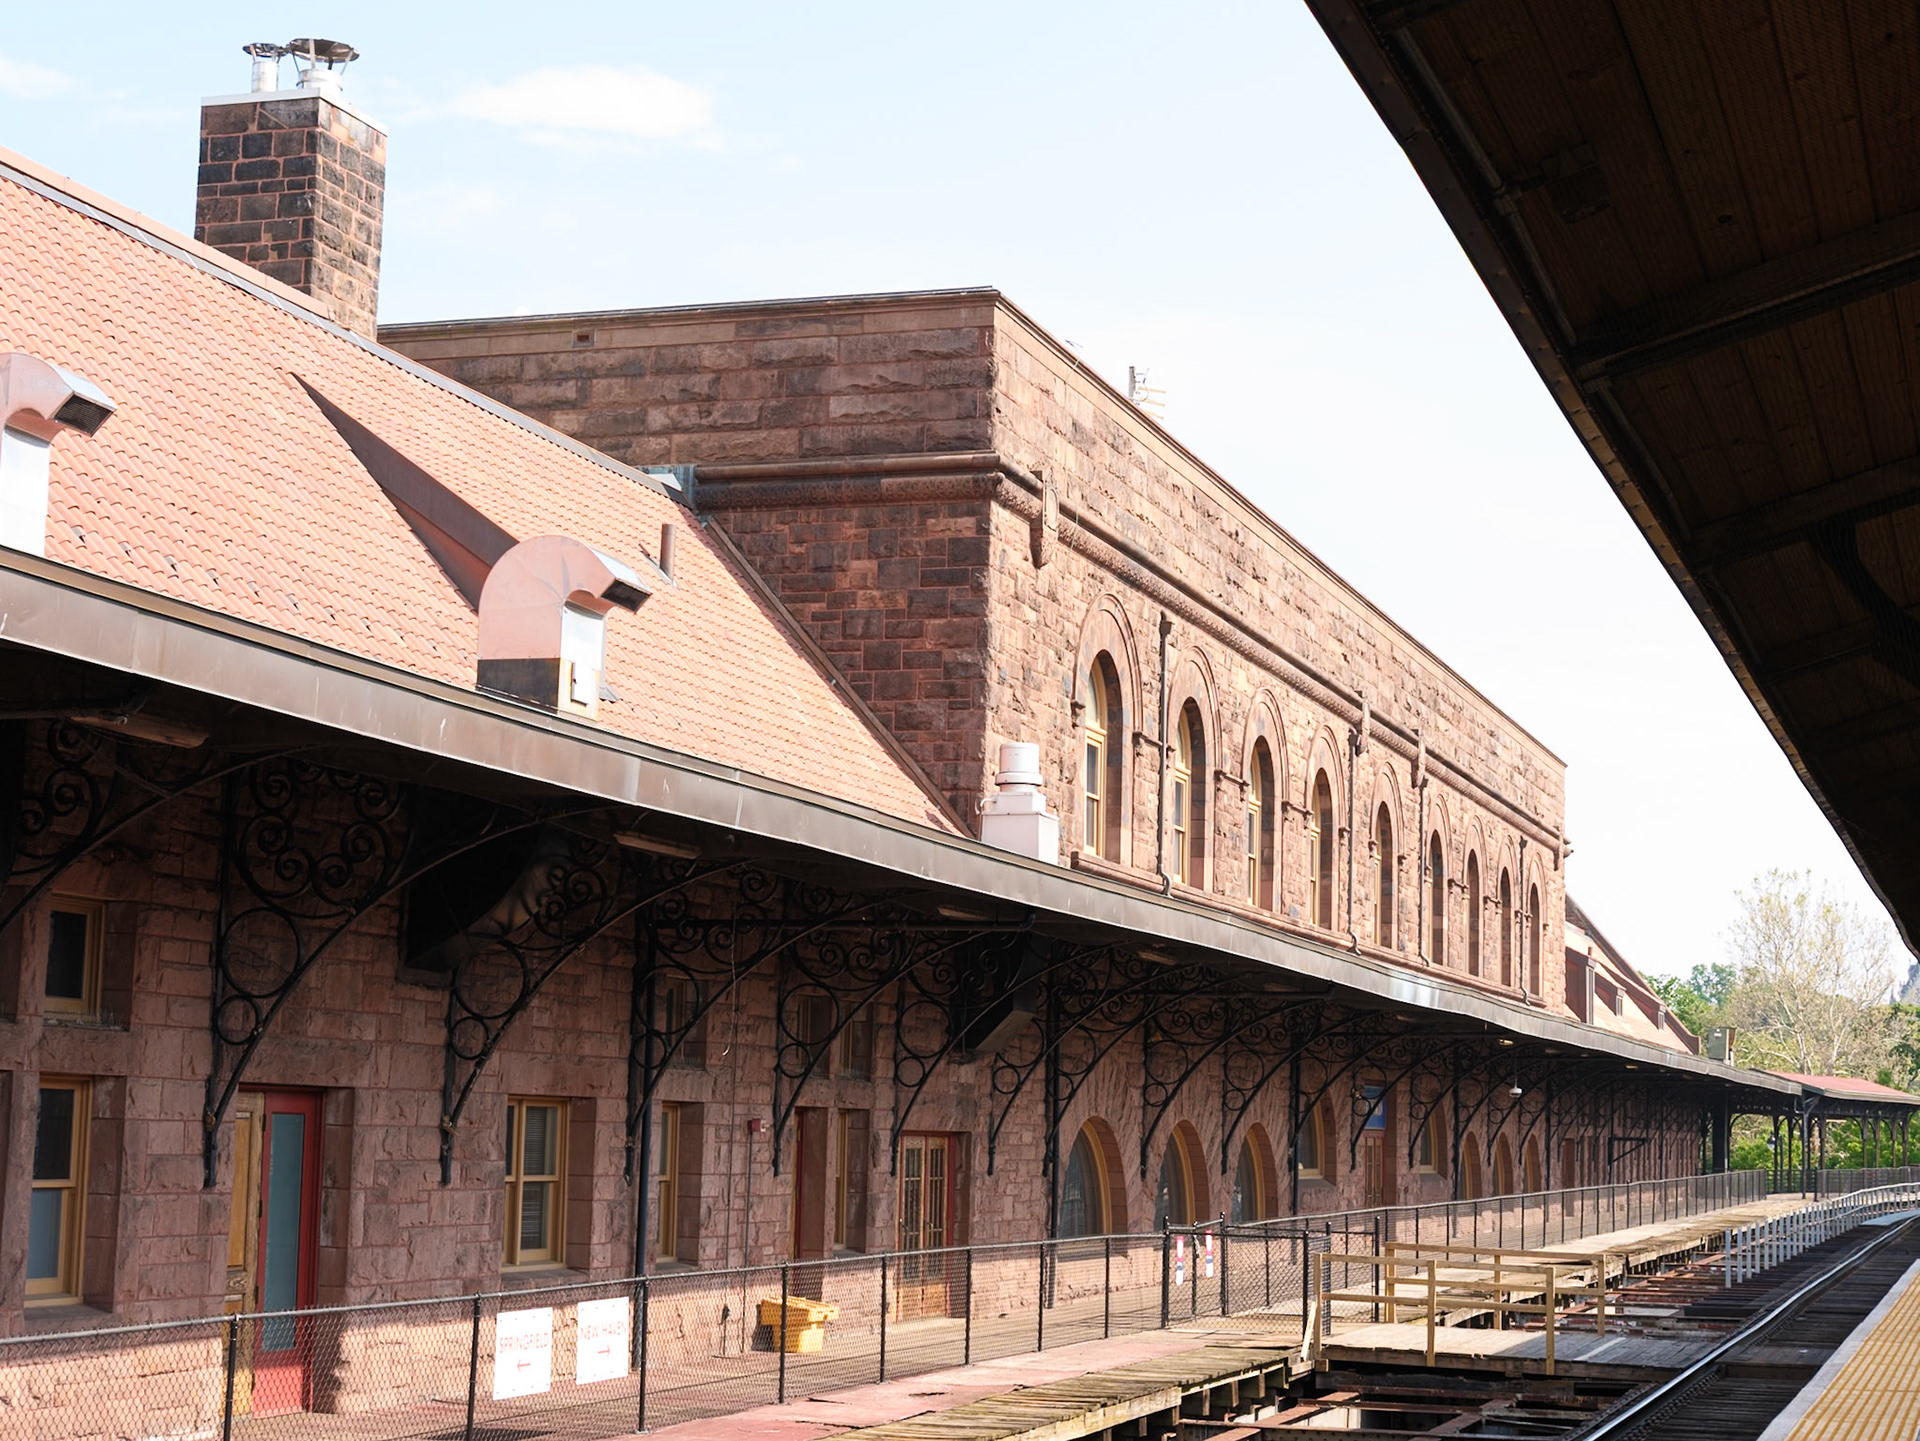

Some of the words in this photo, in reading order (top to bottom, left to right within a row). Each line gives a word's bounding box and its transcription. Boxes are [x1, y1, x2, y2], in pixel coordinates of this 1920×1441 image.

[580, 1325, 599, 1341] NEW
[601, 1320, 627, 1338] HAVEN
[499, 1332, 549, 1354] SPRINGFIELD
